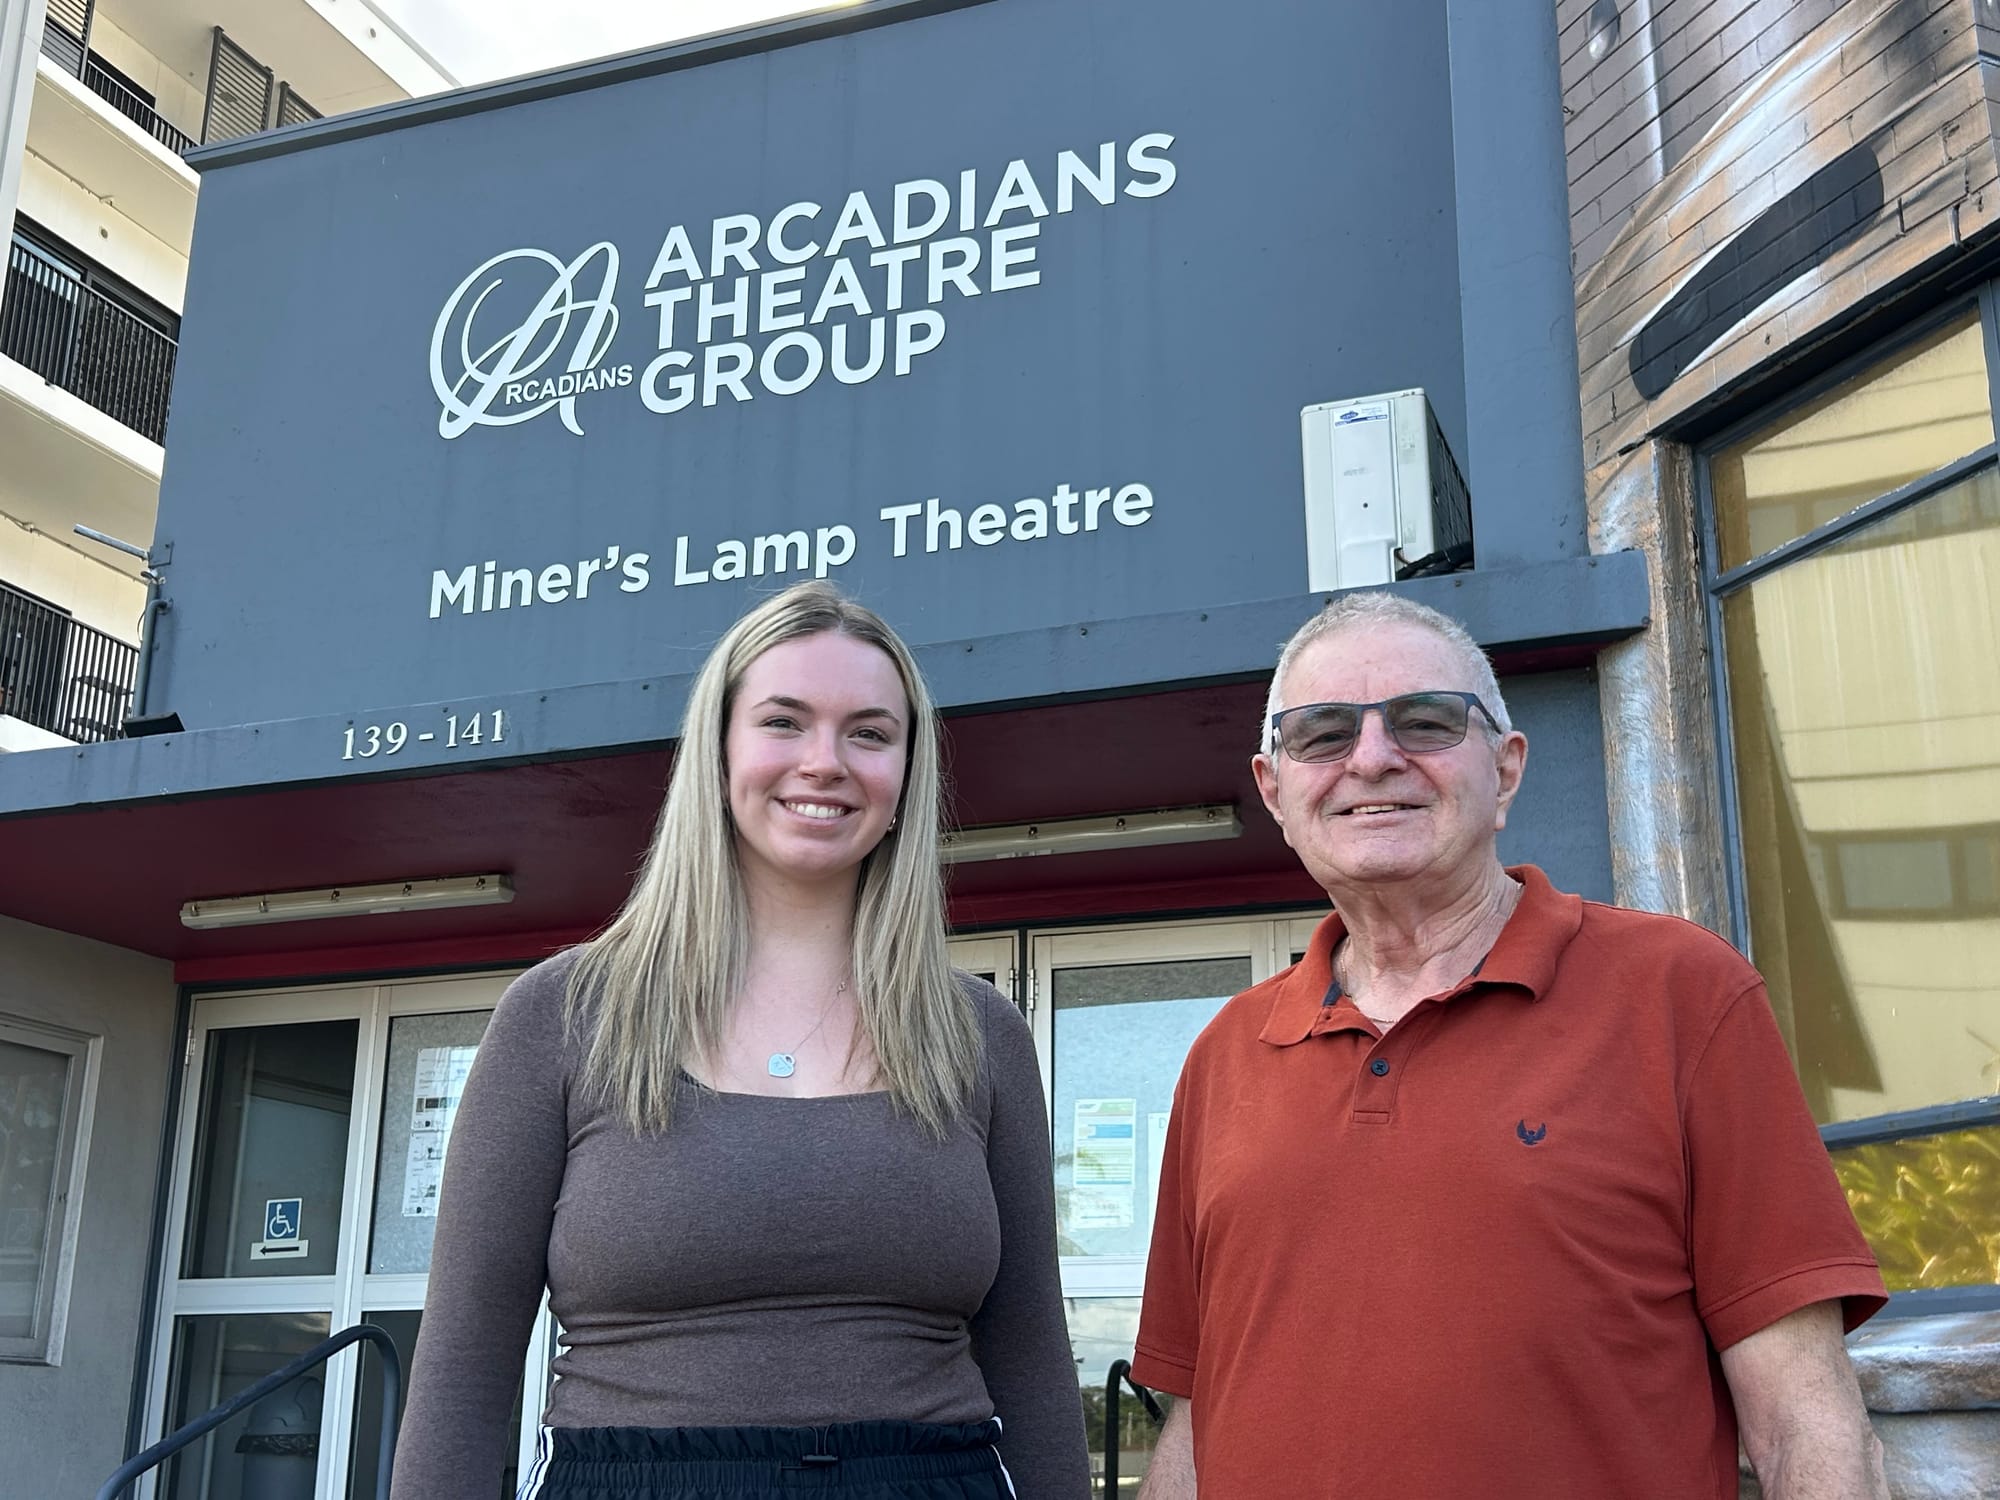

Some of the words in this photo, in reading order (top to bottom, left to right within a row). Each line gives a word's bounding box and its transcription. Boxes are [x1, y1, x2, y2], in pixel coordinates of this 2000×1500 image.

[644, 132, 1178, 290] ARCADIANS
[643, 222, 1042, 350] THEATRE
[639, 309, 947, 415] GROUP
[429, 545, 651, 619] Miner’s
[674, 524, 857, 586] Lamp
[880, 483, 1155, 558] Theatre
[341, 722, 409, 760] 139
[445, 709, 504, 748] 141
